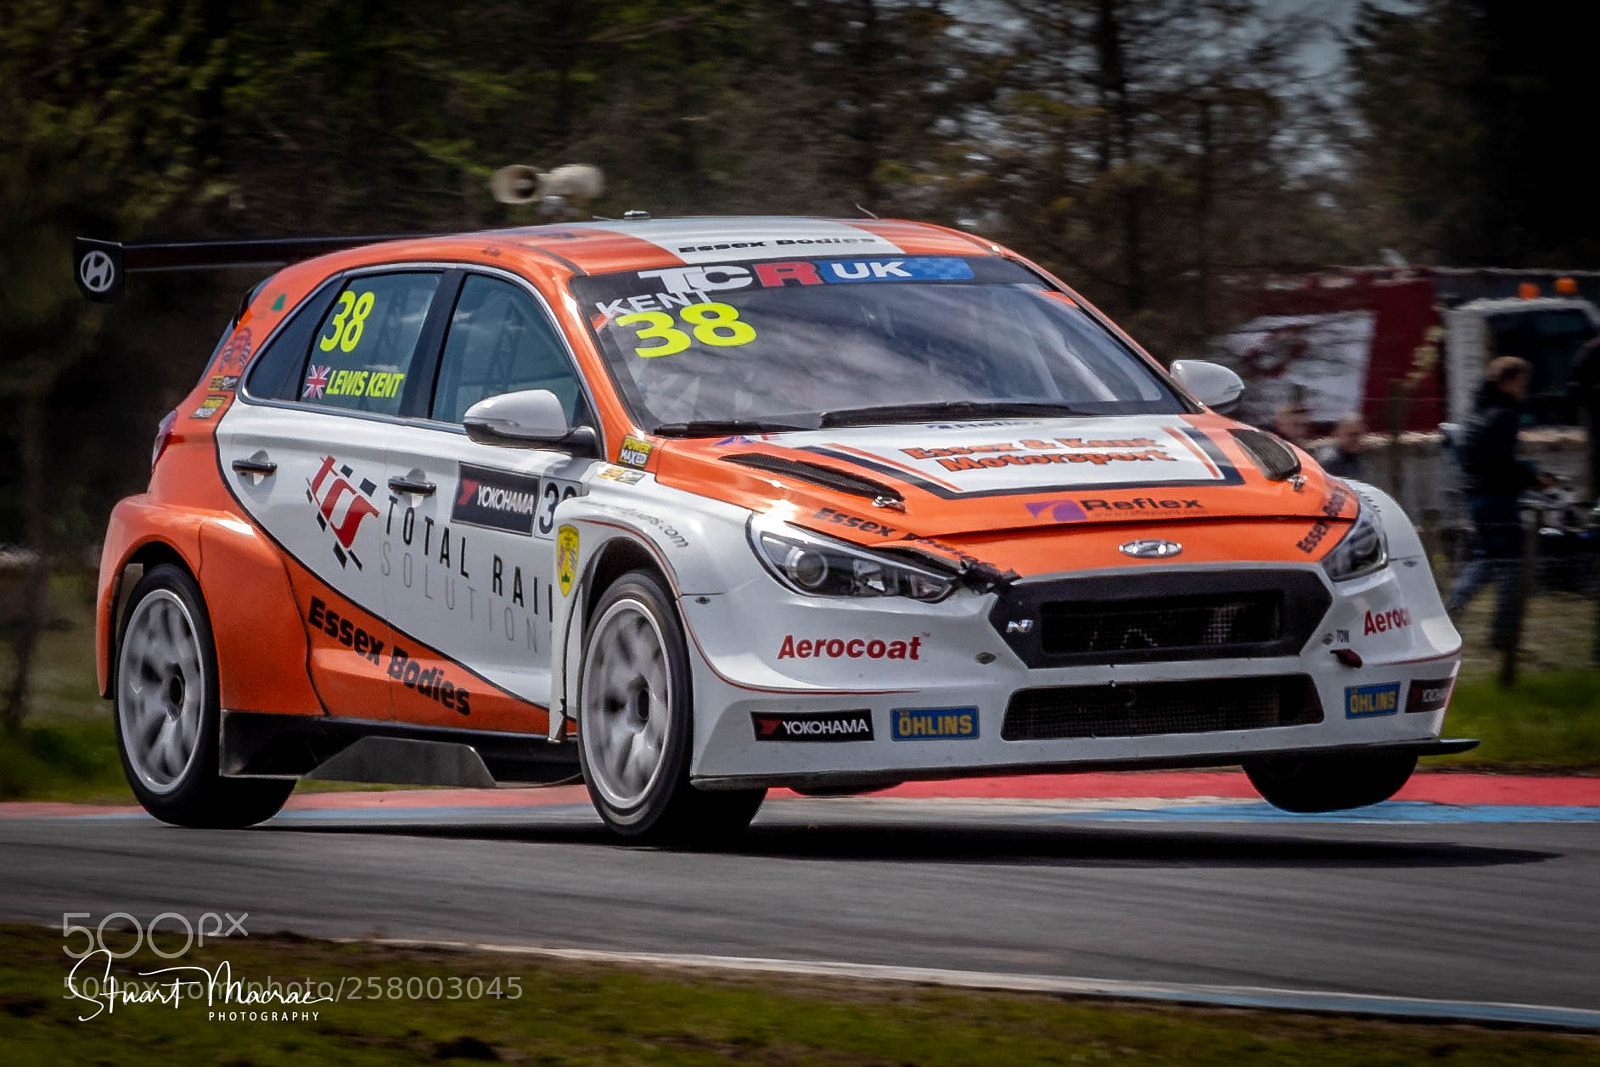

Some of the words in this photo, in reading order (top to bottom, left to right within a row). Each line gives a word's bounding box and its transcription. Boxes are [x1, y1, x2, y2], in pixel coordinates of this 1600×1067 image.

[678, 240, 765, 253] Essex
[637, 261, 824, 294] TCR
[831, 261, 912, 280] UK
[595, 289, 713, 318] KENT
[319, 290, 375, 353] 38
[615, 302, 757, 359] 38
[325, 369, 365, 396] LEWIS
[366, 371, 405, 399] KENT
[936, 449, 1178, 472] Motorsport
[476, 484, 535, 515] YOKOHAMA
[1080, 497, 1204, 511] Reflex
[386, 495, 470, 579] TOTAL
[812, 507, 897, 537] Essex
[308, 596, 384, 665] Essex
[386, 642, 471, 716] Bodies
[777, 634, 921, 660] Aerocoat
[782, 718, 869, 736] YOKOHAMA
[898, 712, 973, 737] ÖHLINS
